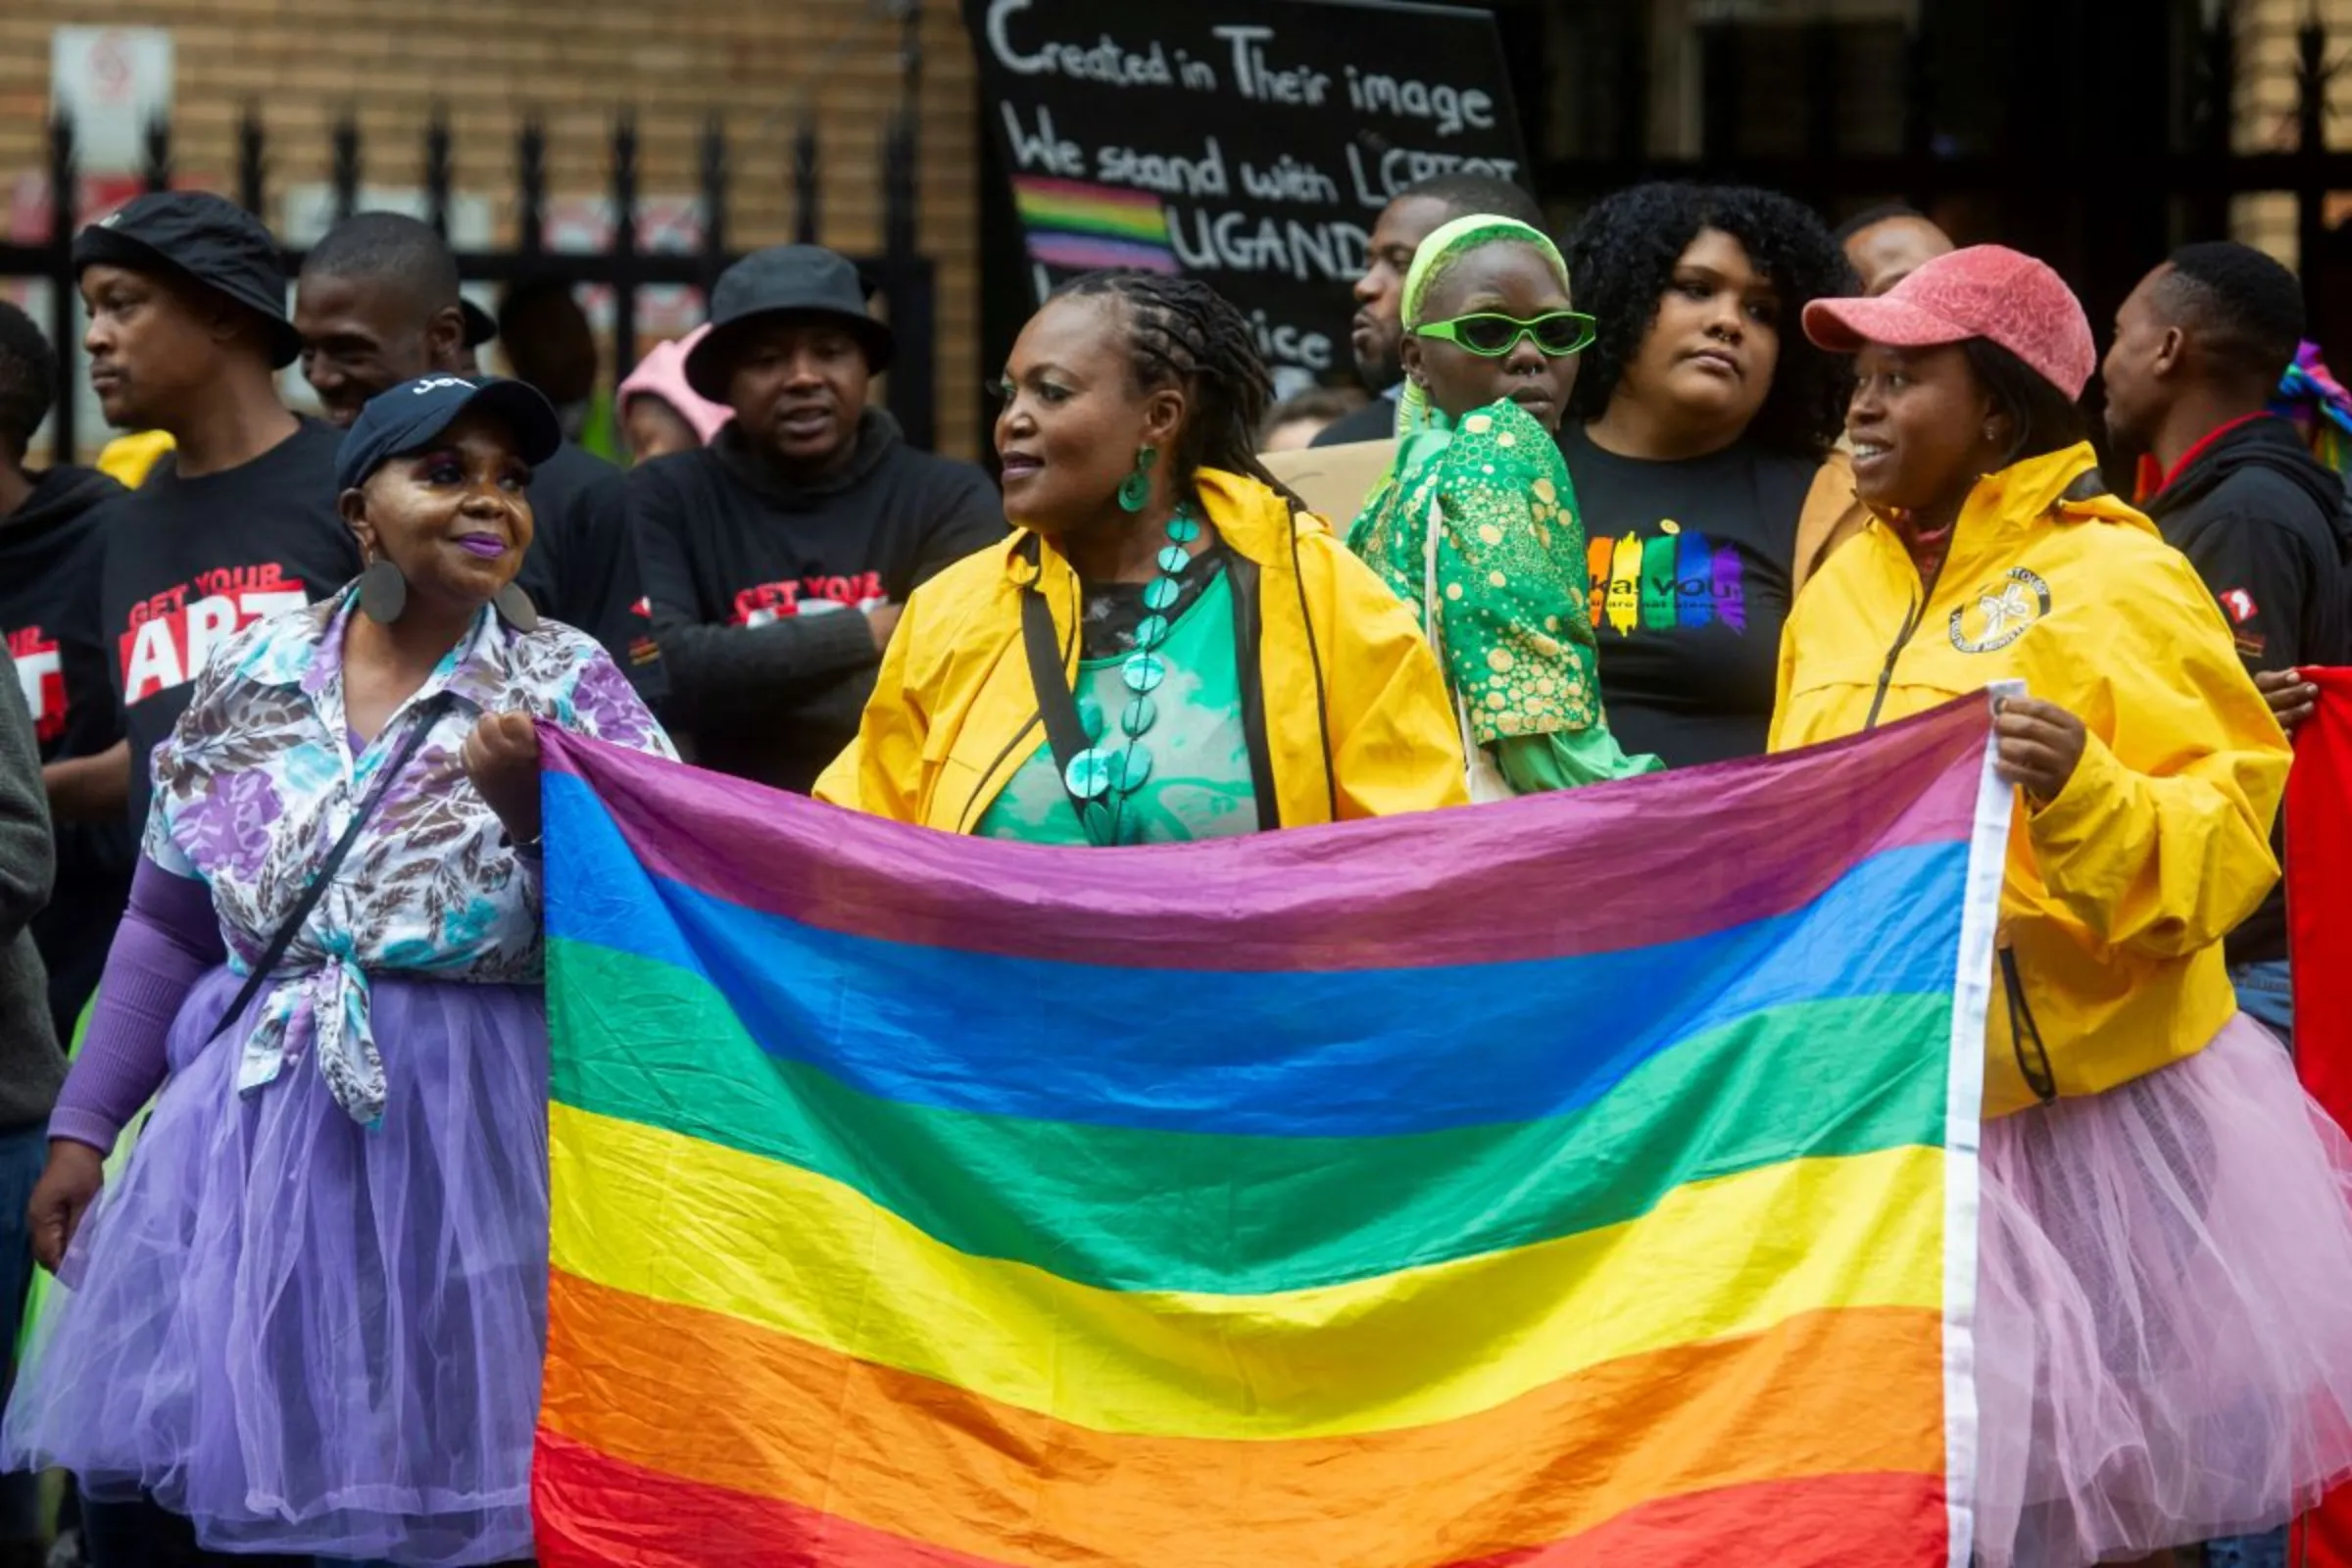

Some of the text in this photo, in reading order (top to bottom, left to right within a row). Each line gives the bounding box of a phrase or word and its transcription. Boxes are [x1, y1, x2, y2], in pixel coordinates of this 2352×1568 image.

[986, 0, 1495, 136] Created in Their image
[1000, 101, 1085, 172] We
[1098, 136, 1228, 197] stand
[1241, 154, 1340, 204] with
[1245, 308, 1333, 370] ice
[128, 562, 285, 629] GET YOUR
[734, 580, 800, 621] GET
[124, 590, 310, 708] ART
